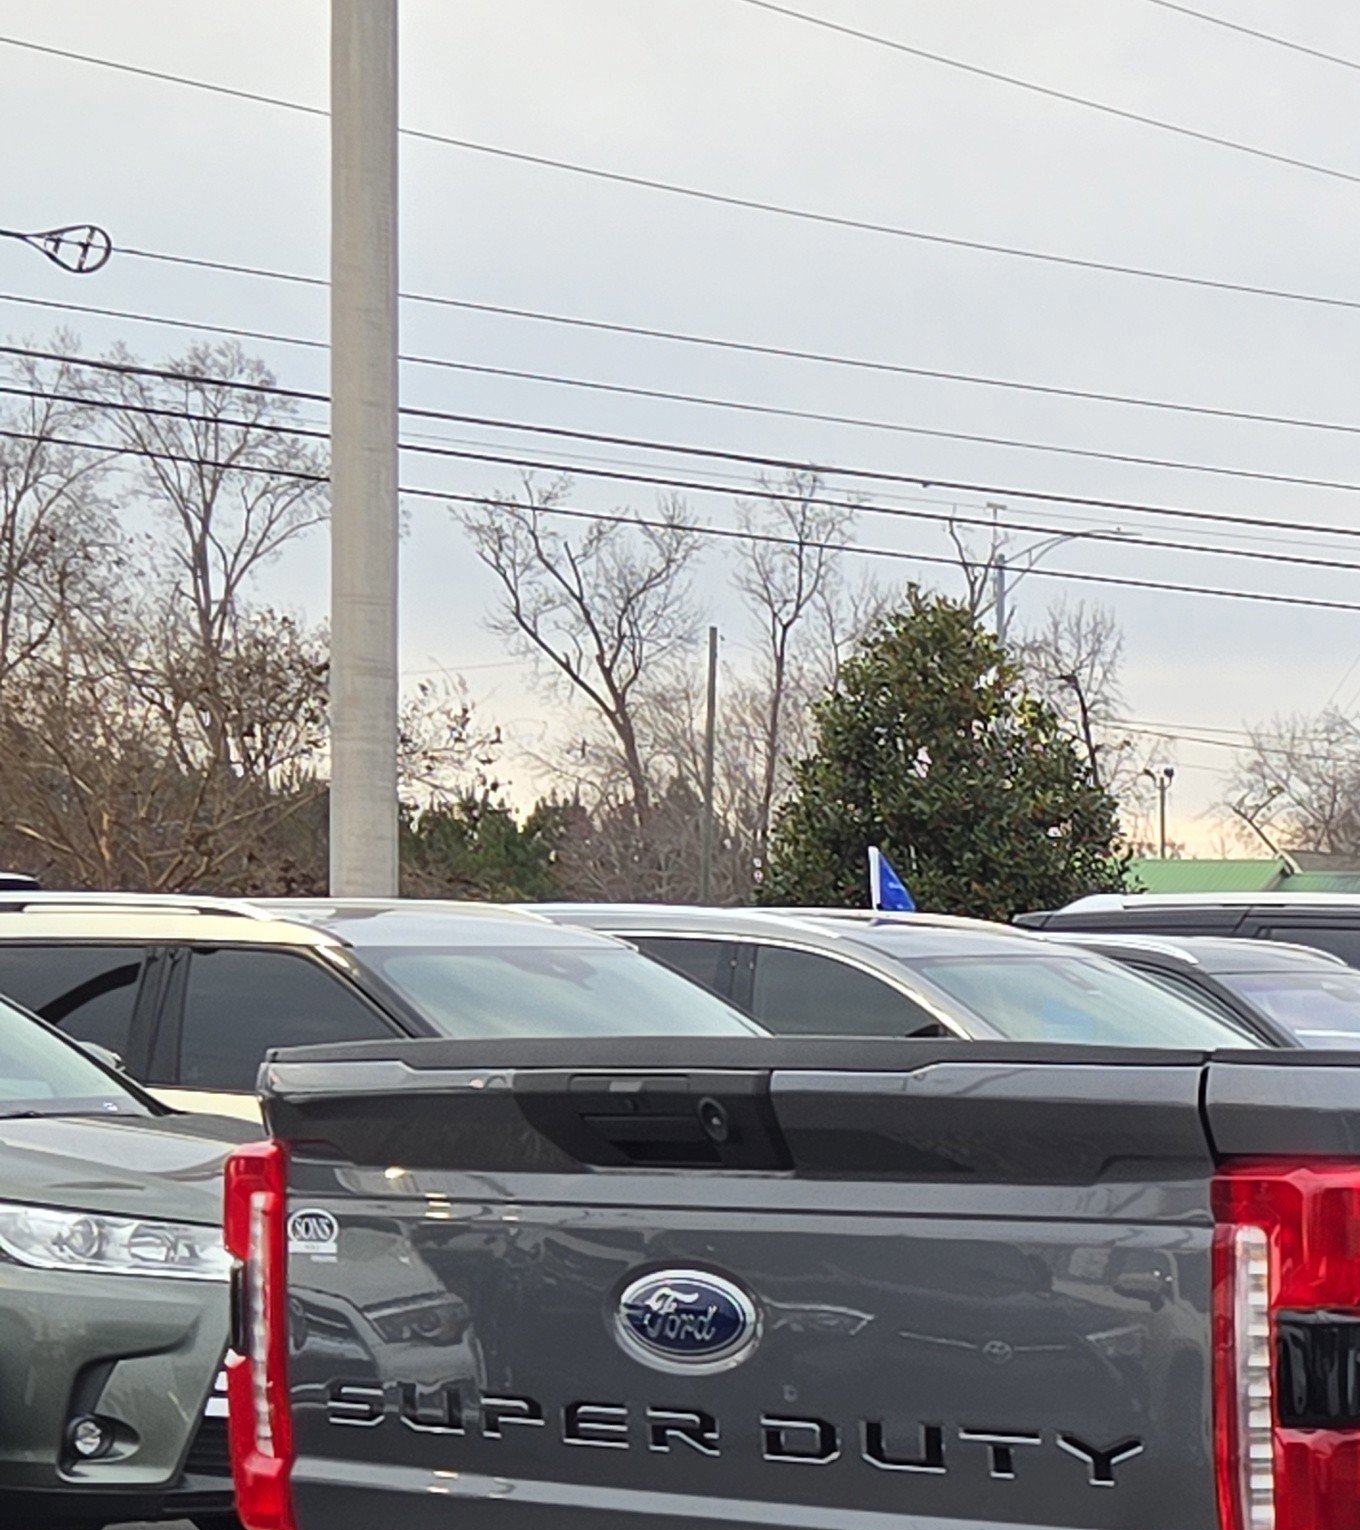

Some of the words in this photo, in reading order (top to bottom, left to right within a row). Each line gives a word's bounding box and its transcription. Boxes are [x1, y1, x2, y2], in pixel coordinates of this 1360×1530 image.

[643, 1286, 718, 1340] Ford
[328, 1383, 720, 1457] SUPER
[760, 1411, 1144, 1487] DUTY
